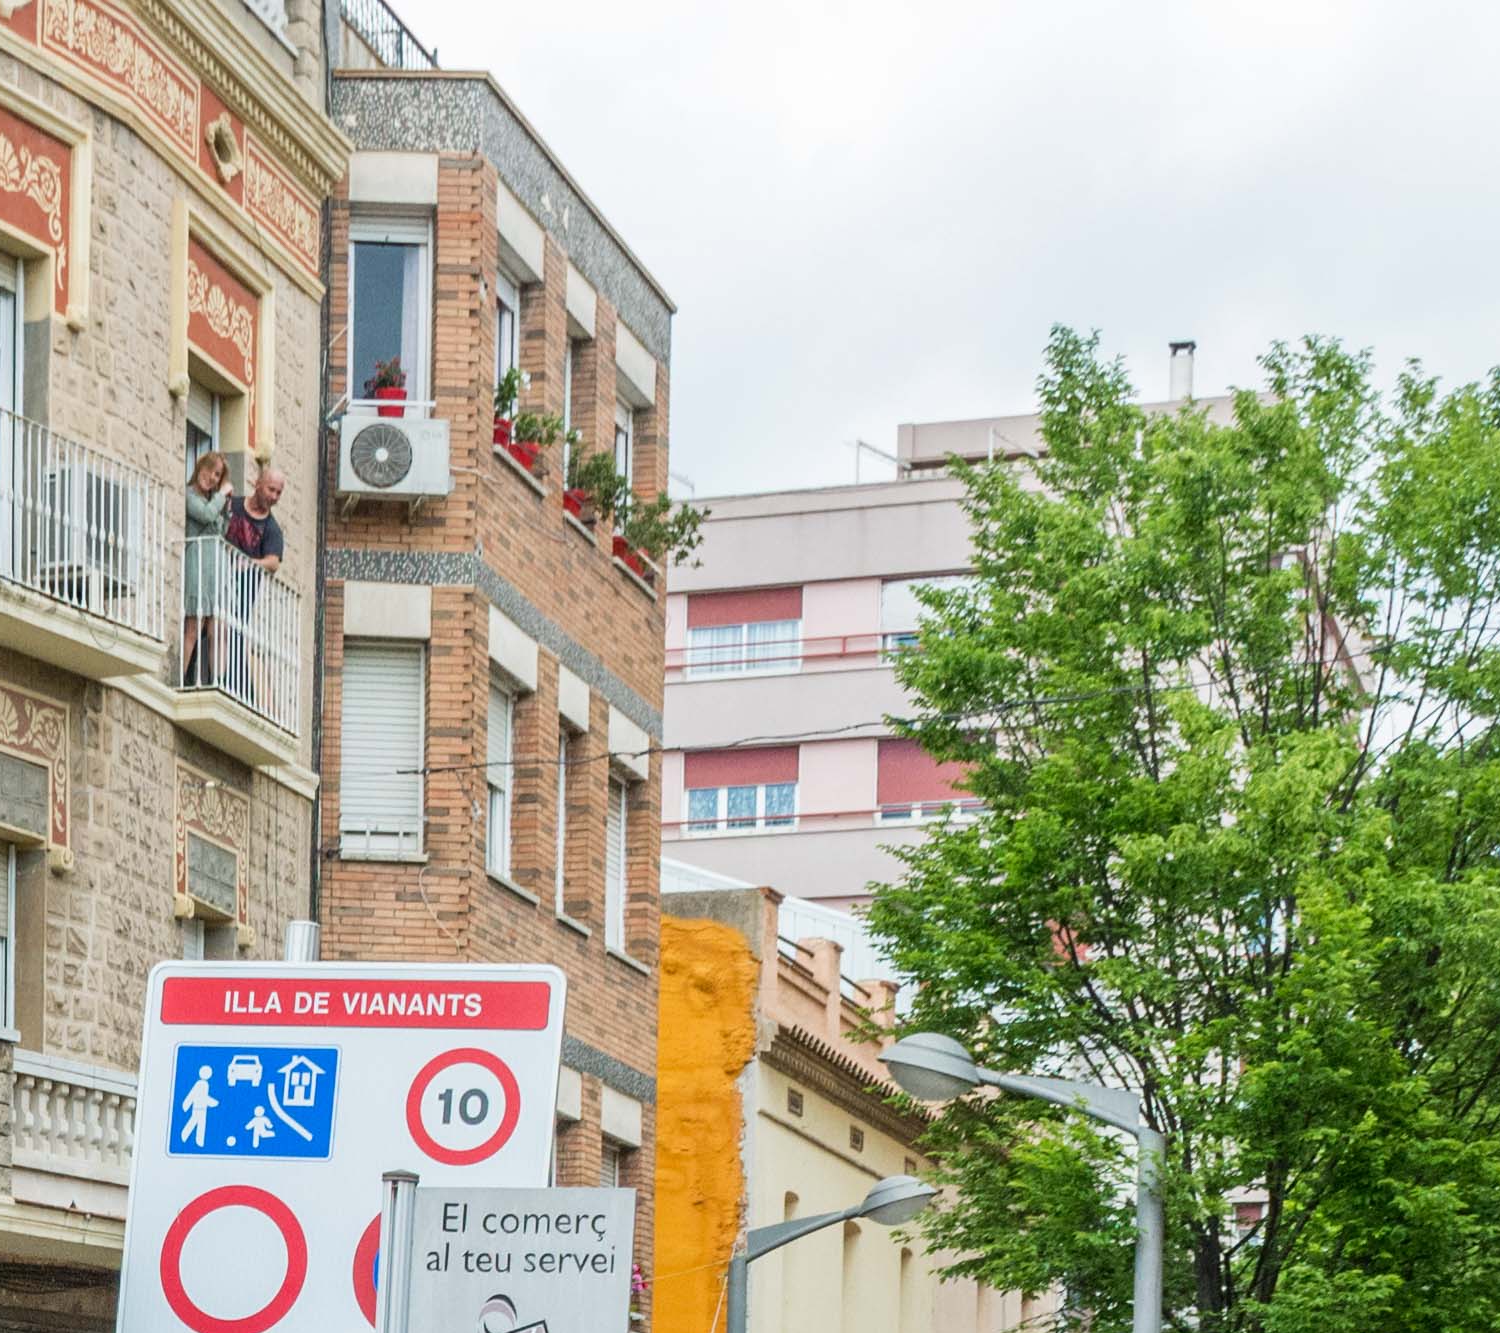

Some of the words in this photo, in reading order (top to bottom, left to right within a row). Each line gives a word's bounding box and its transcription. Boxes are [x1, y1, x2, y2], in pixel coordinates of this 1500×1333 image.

[223, 991, 283, 1014] ILLA
[293, 991, 330, 1015] DE
[342, 992, 483, 1017] VIANANTS
[437, 1088, 490, 1126] 10
[442, 1202, 468, 1233] El
[482, 1212, 606, 1242] comerç
[426, 1242, 450, 1273] al
[462, 1249, 511, 1273] teu
[523, 1246, 616, 1274] servei
